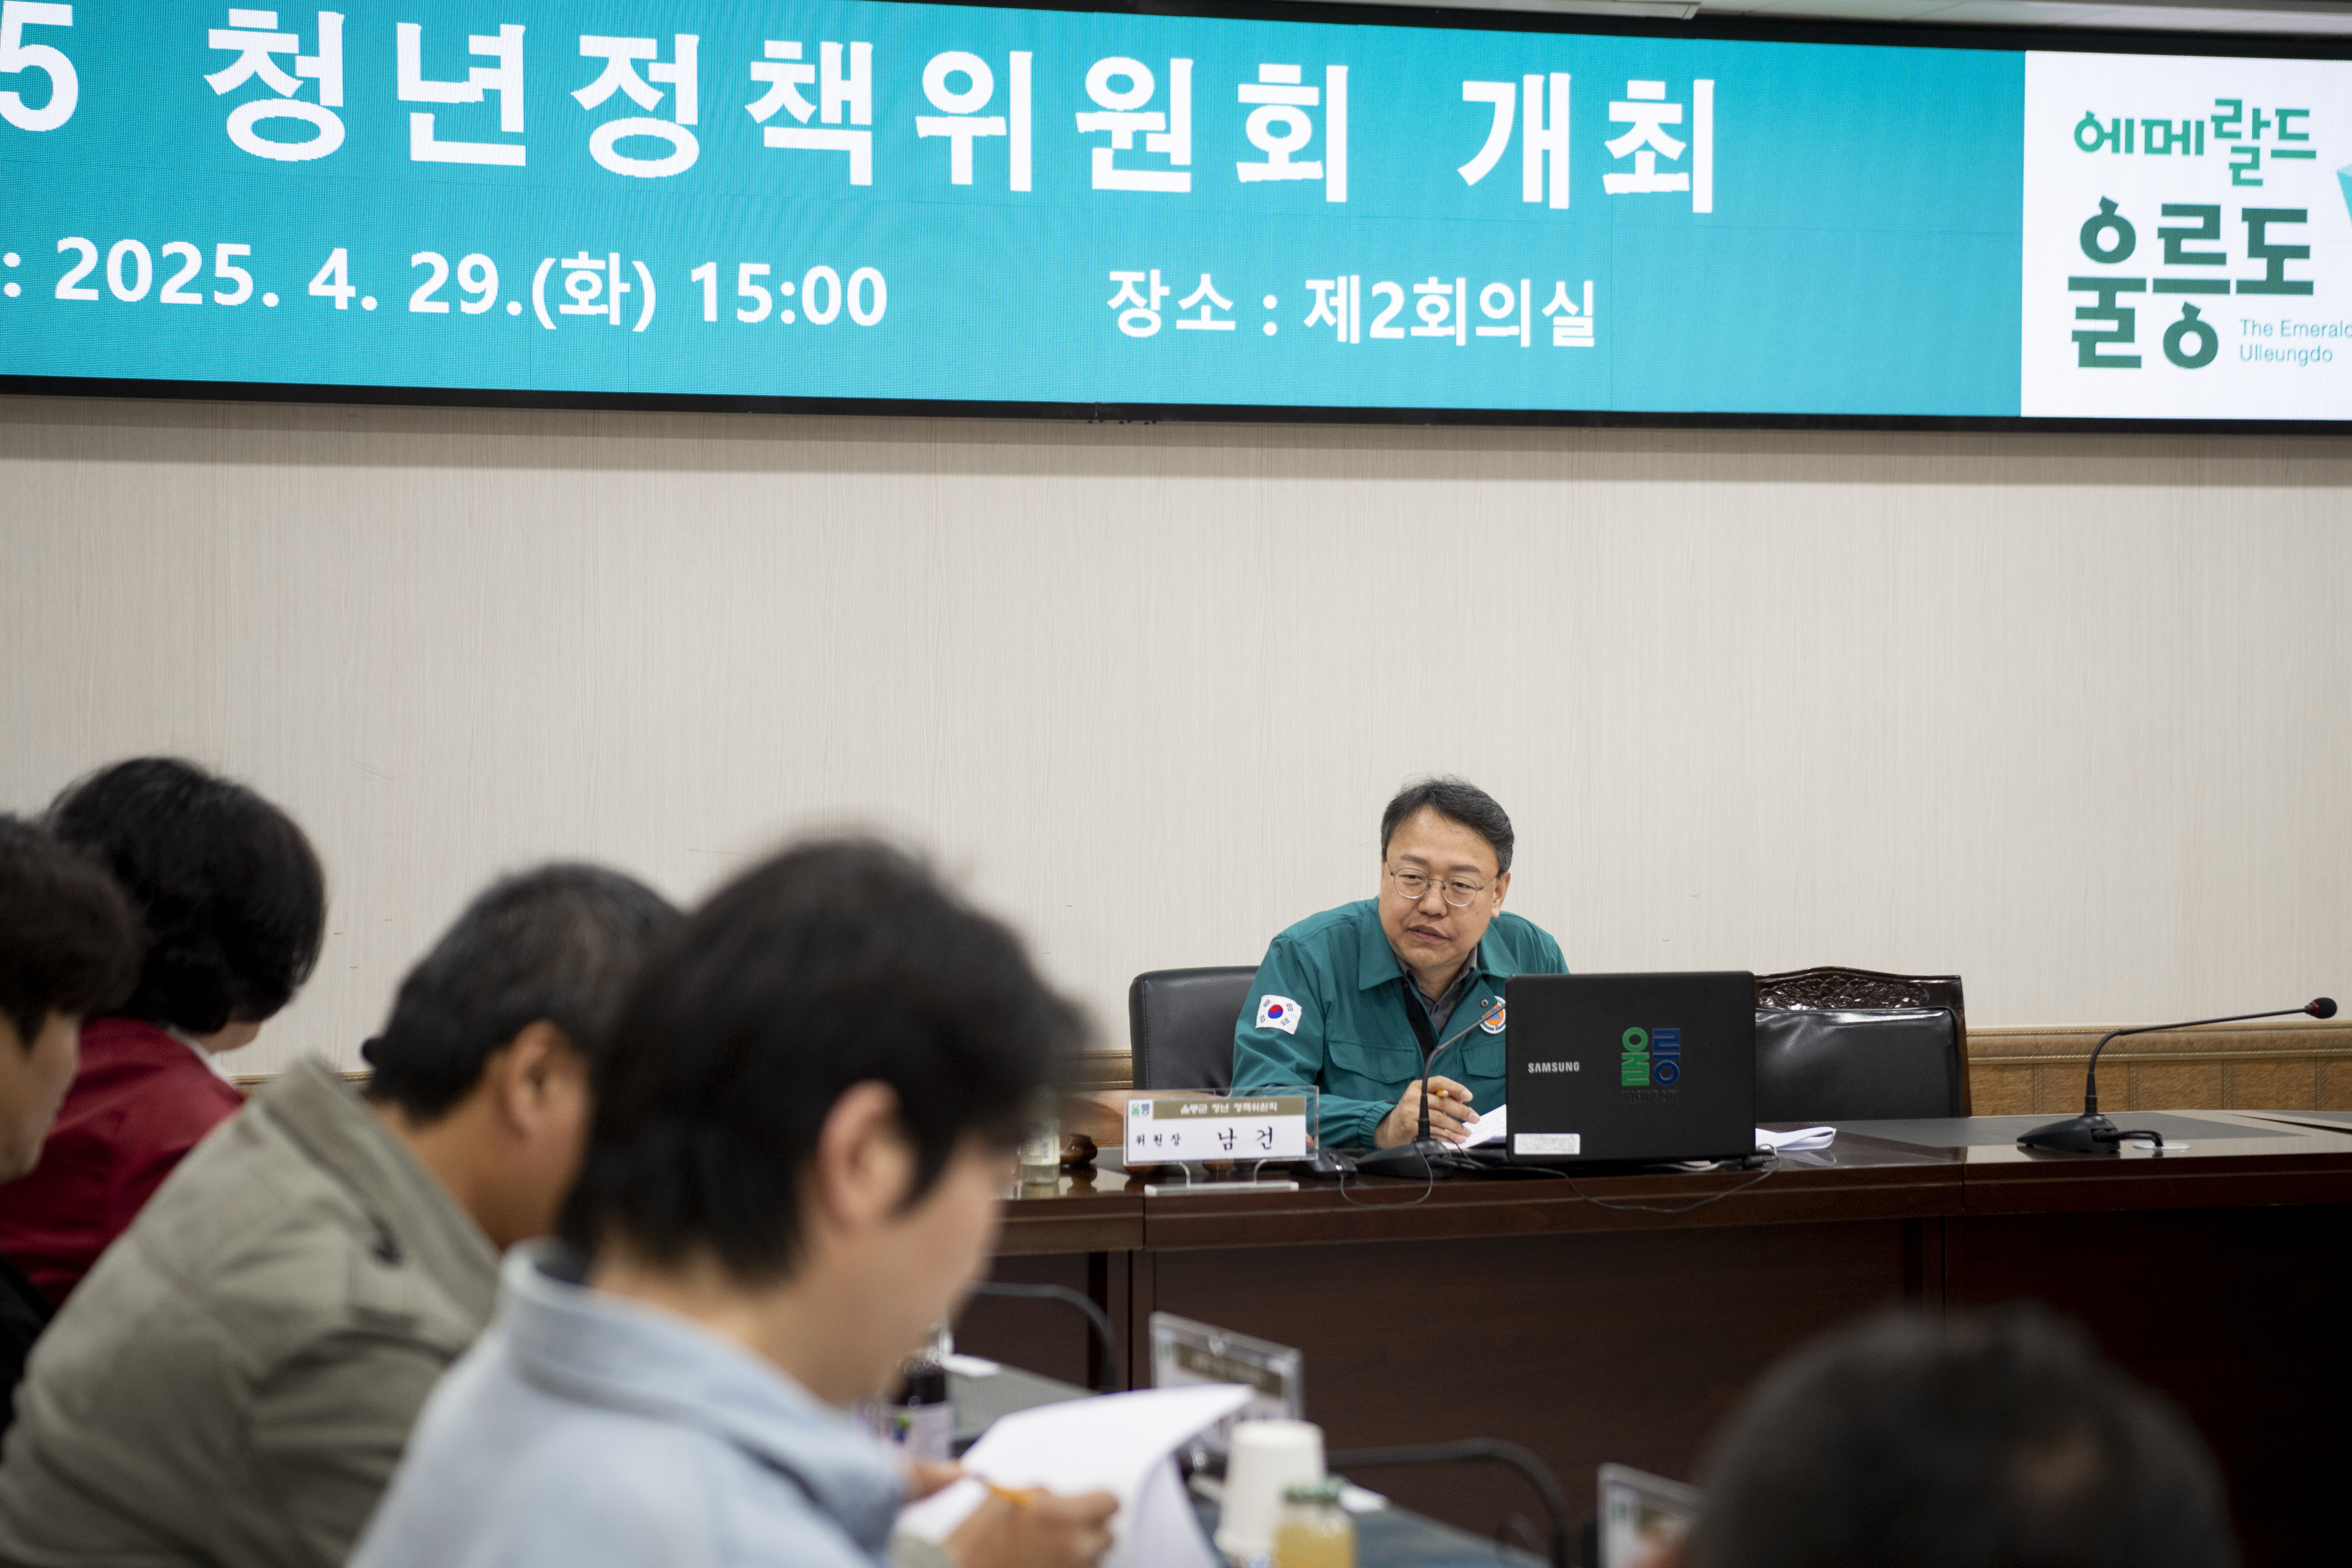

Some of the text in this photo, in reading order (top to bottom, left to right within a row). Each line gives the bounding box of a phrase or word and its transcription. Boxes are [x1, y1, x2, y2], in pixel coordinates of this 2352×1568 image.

[204, 9, 1348, 202] 청년정책위원회
[1457, 73, 1714, 213] 개최
[2074, 98, 2317, 187] 에메랄드
[55, 237, 279, 307] 2025.
[308, 248, 378, 311] 4.
[409, 251, 656, 332] 29.(화)
[691, 261, 887, 326] 15:00
[1107, 268, 1237, 338] 장소
[1303, 274, 1595, 348] 제2회의실
[2067, 196, 2314, 369] 울릉도
[2239, 344, 2333, 367] Ulleungdo
[2240, 319, 2273, 337] The
[1528, 1061, 1580, 1074] SAMSUNG
